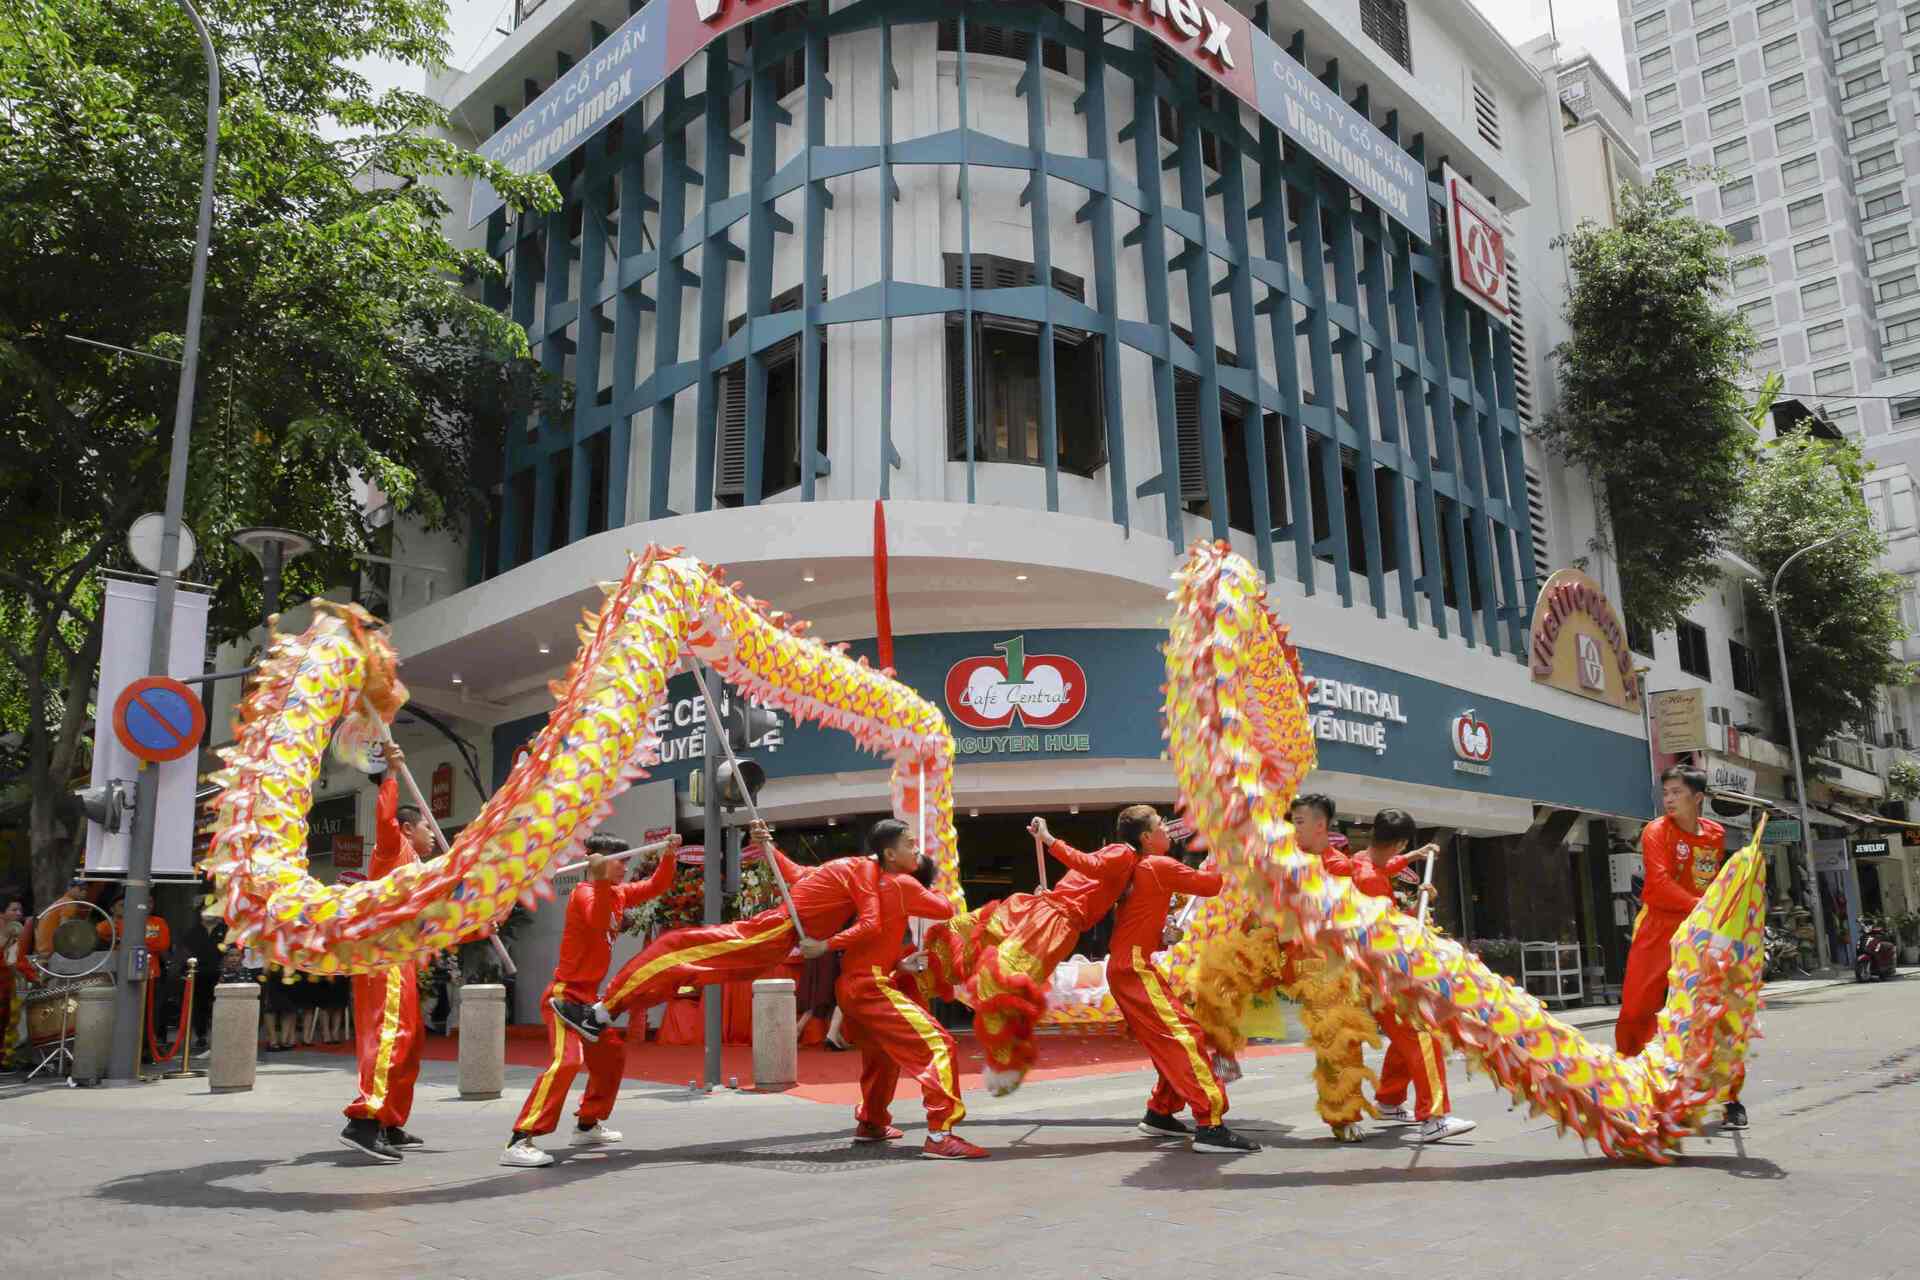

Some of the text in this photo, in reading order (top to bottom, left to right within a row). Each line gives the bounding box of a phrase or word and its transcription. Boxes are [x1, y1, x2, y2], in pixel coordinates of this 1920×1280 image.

[539, 95, 561, 125] TY
[1325, 102, 1345, 129] TY
[1284, 93, 1409, 218] Vietronimex
[1044, 732, 1091, 752] HUE
[1855, 843, 1886, 854] JEWELRY
